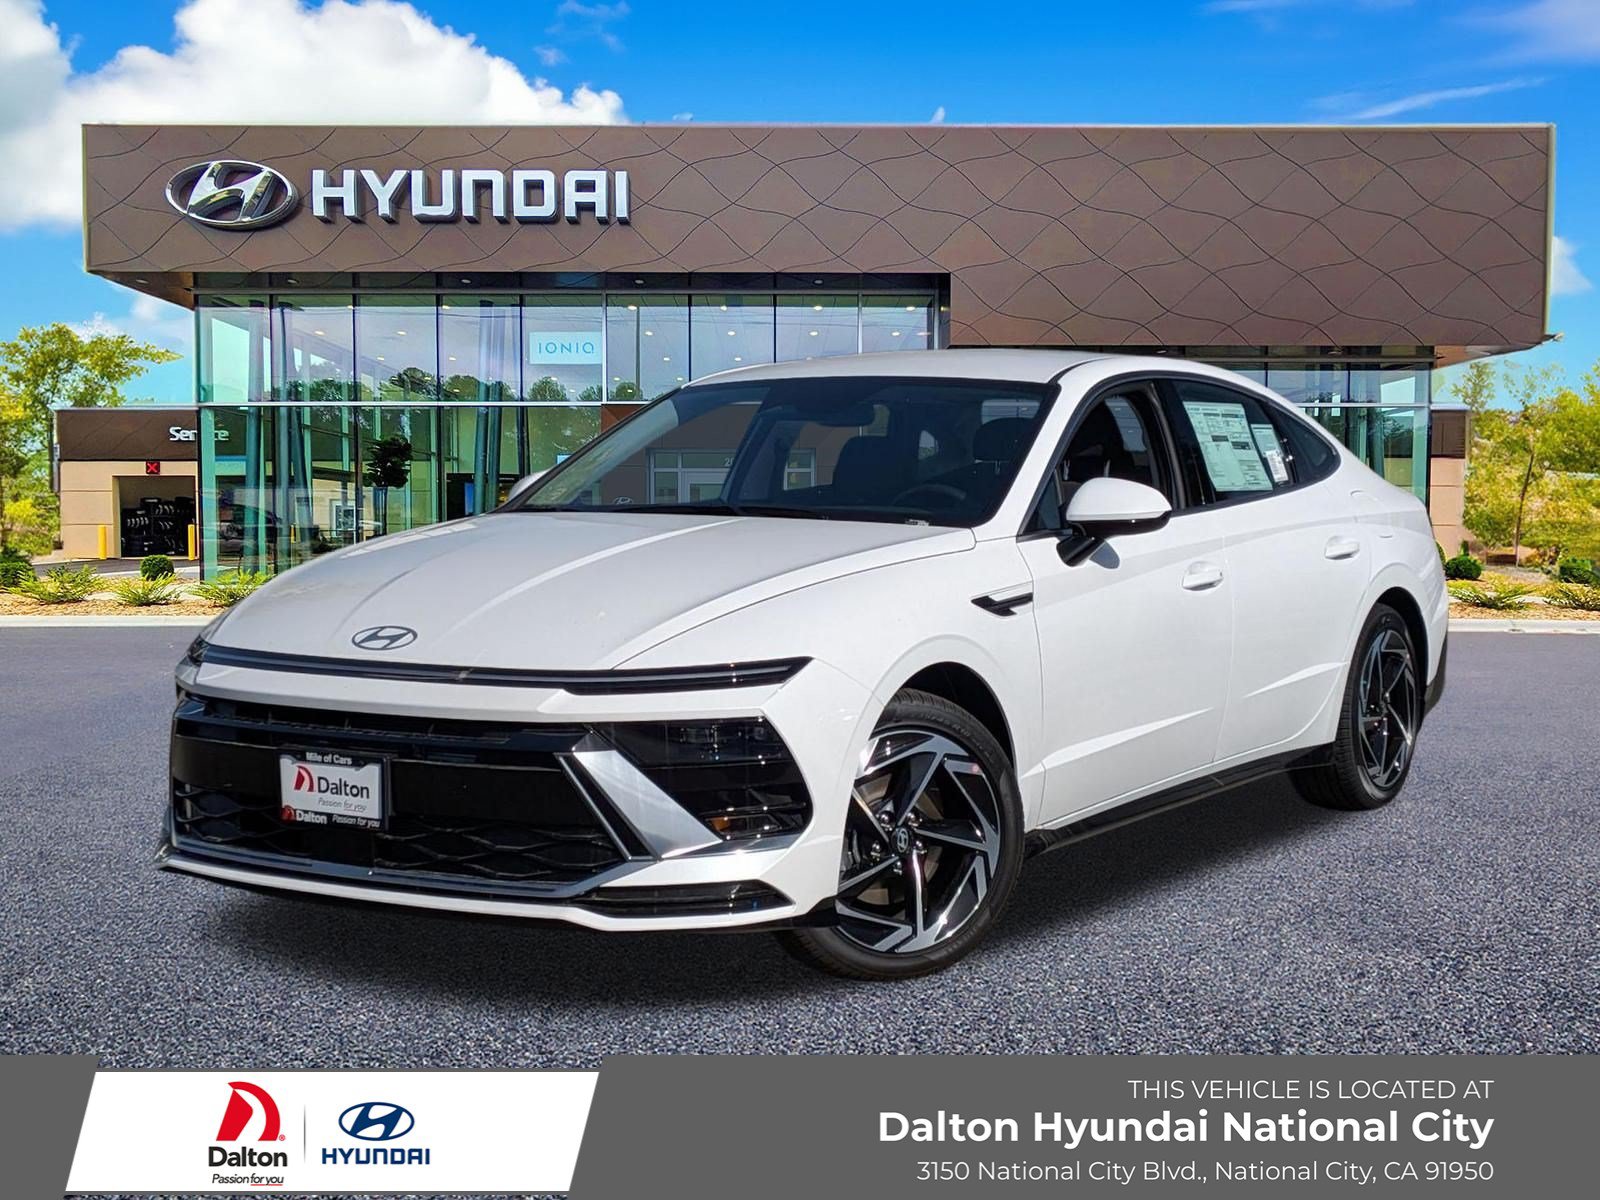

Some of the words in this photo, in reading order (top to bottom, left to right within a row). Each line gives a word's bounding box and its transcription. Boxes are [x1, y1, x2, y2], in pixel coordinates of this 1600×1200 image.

[311, 169, 631, 224] HYUNDAI
[538, 341, 595, 355] IONIQ
[169, 426, 230, 441] Sere
[317, 776, 370, 799] Dalton
[296, 810, 328, 825] Dalton
